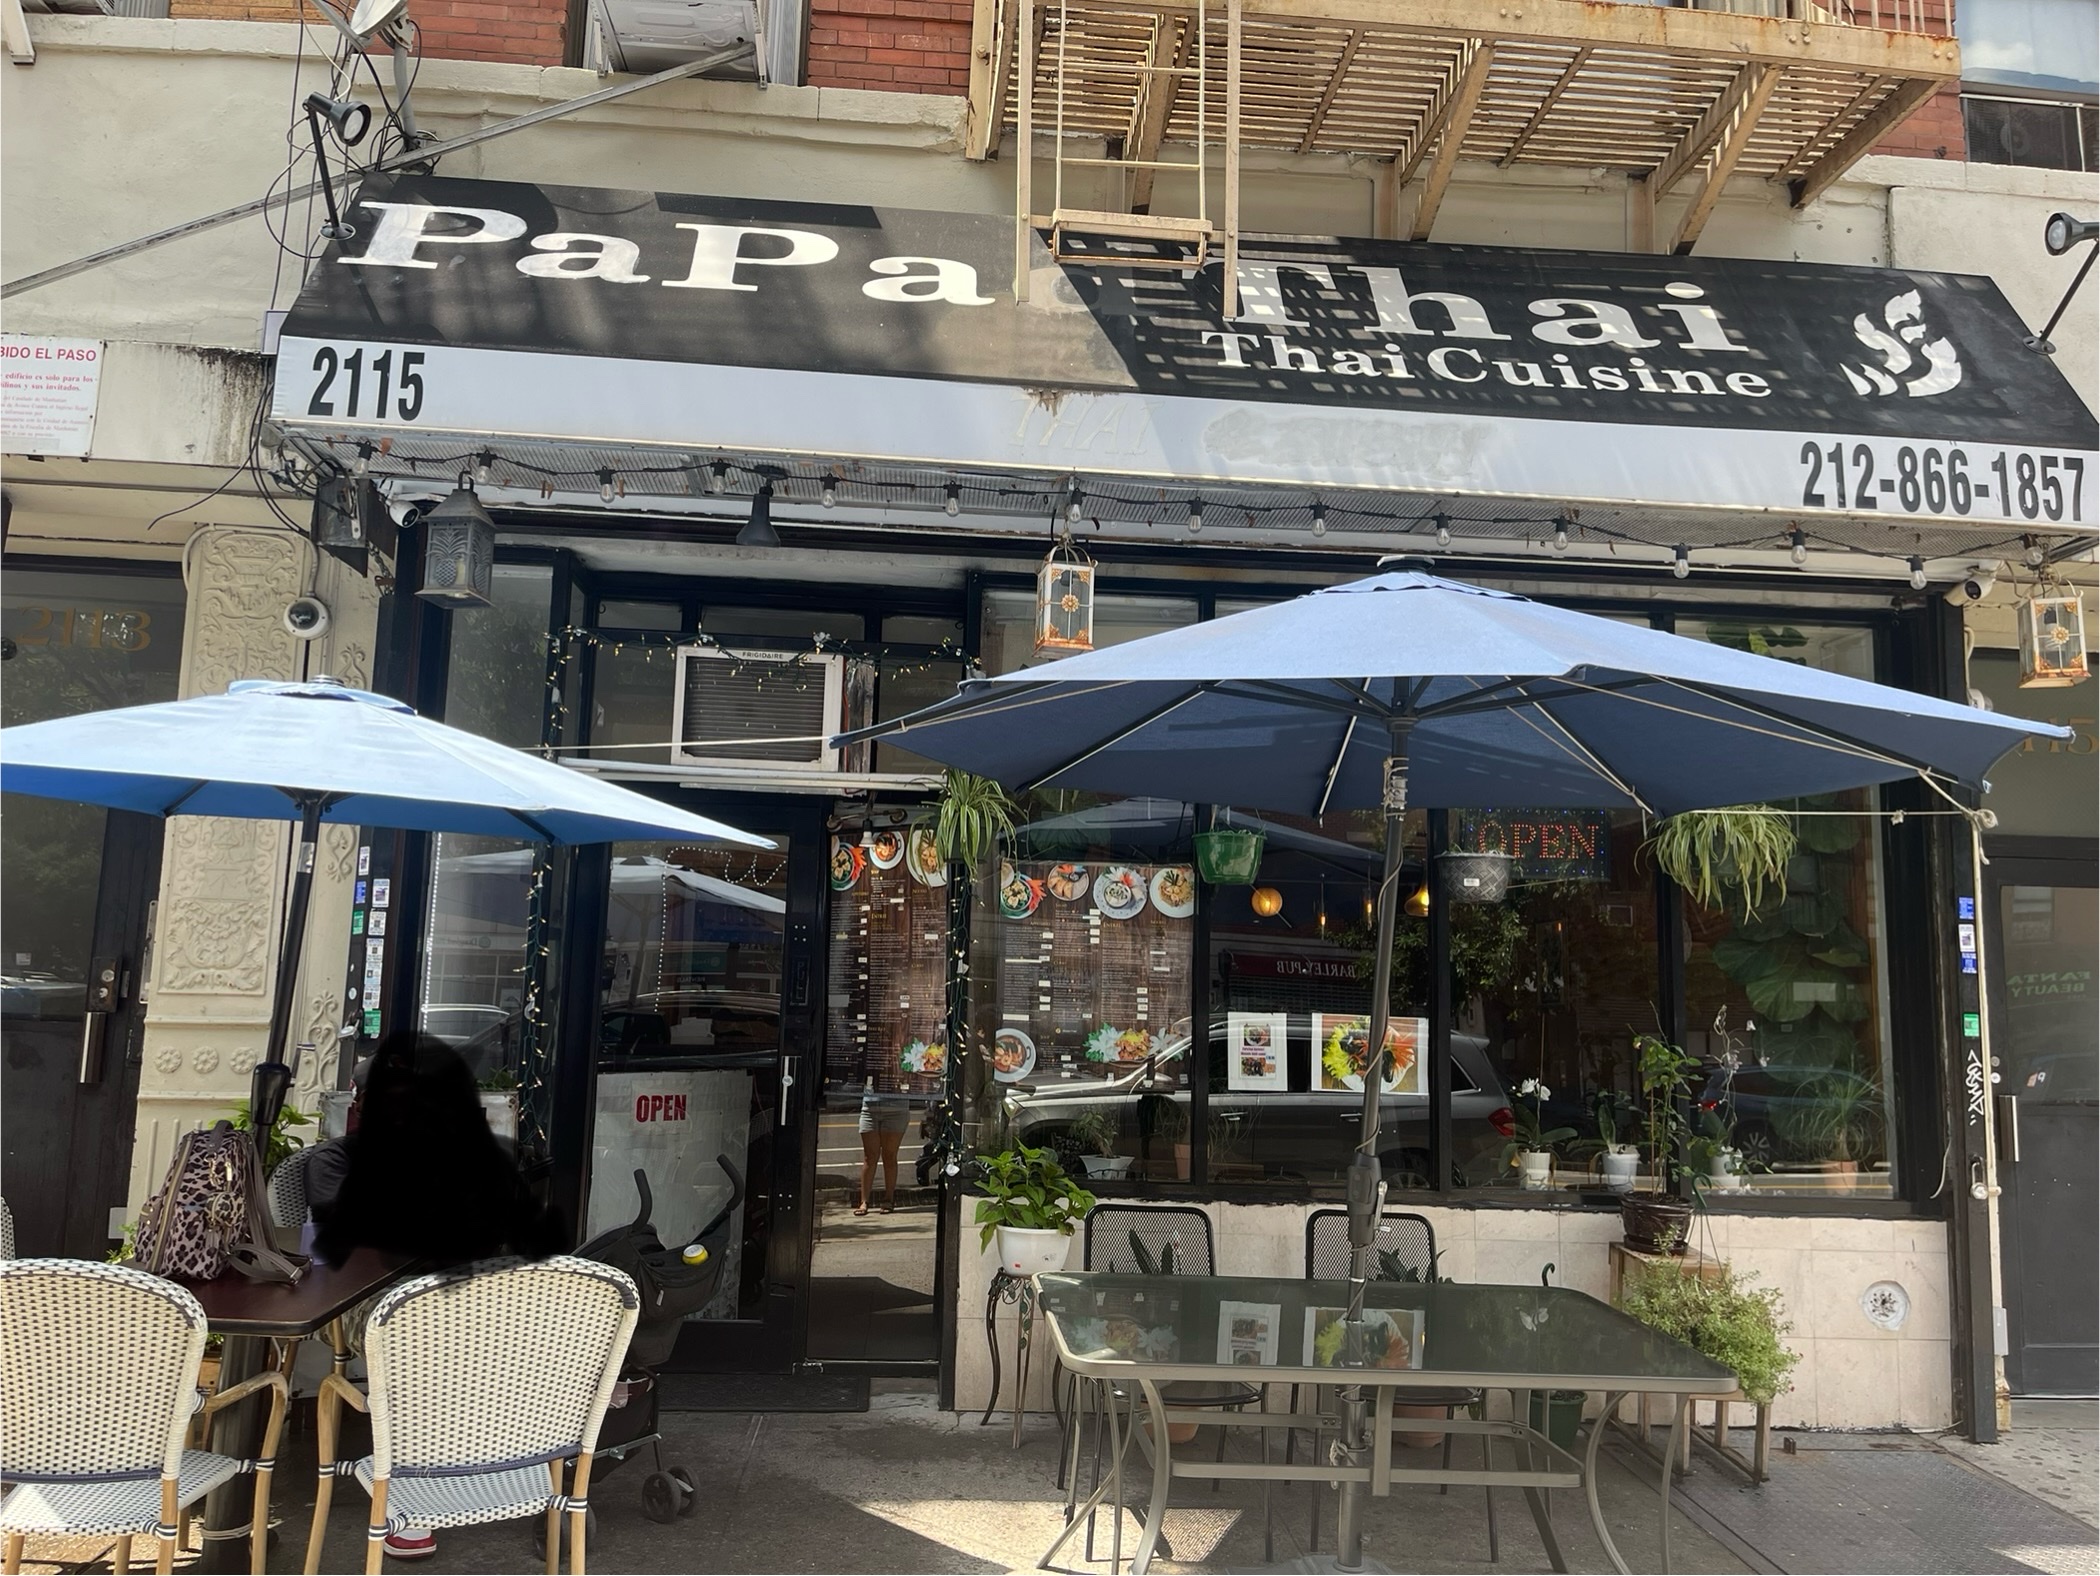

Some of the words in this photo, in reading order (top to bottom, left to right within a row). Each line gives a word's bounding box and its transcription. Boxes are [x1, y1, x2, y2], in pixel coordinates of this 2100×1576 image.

[1182, 255, 1749, 352] Thai
[5, 372, 33, 380] edificio
[83, 375, 93, 383] los
[35, 347, 52, 360] EL
[57, 348, 97, 362] PASO
[1201, 330, 1416, 380] Thai
[1427, 347, 1772, 398] Cuisine
[308, 346, 425, 422] 2115
[1799, 440, 2086, 522] 212-866-1857
[15, 601, 153, 653] 2113
[742, 651, 784, 660] FRIGIDAIRE
[1478, 820, 1600, 860] OPEN
[635, 1094, 688, 1123] OPEN
